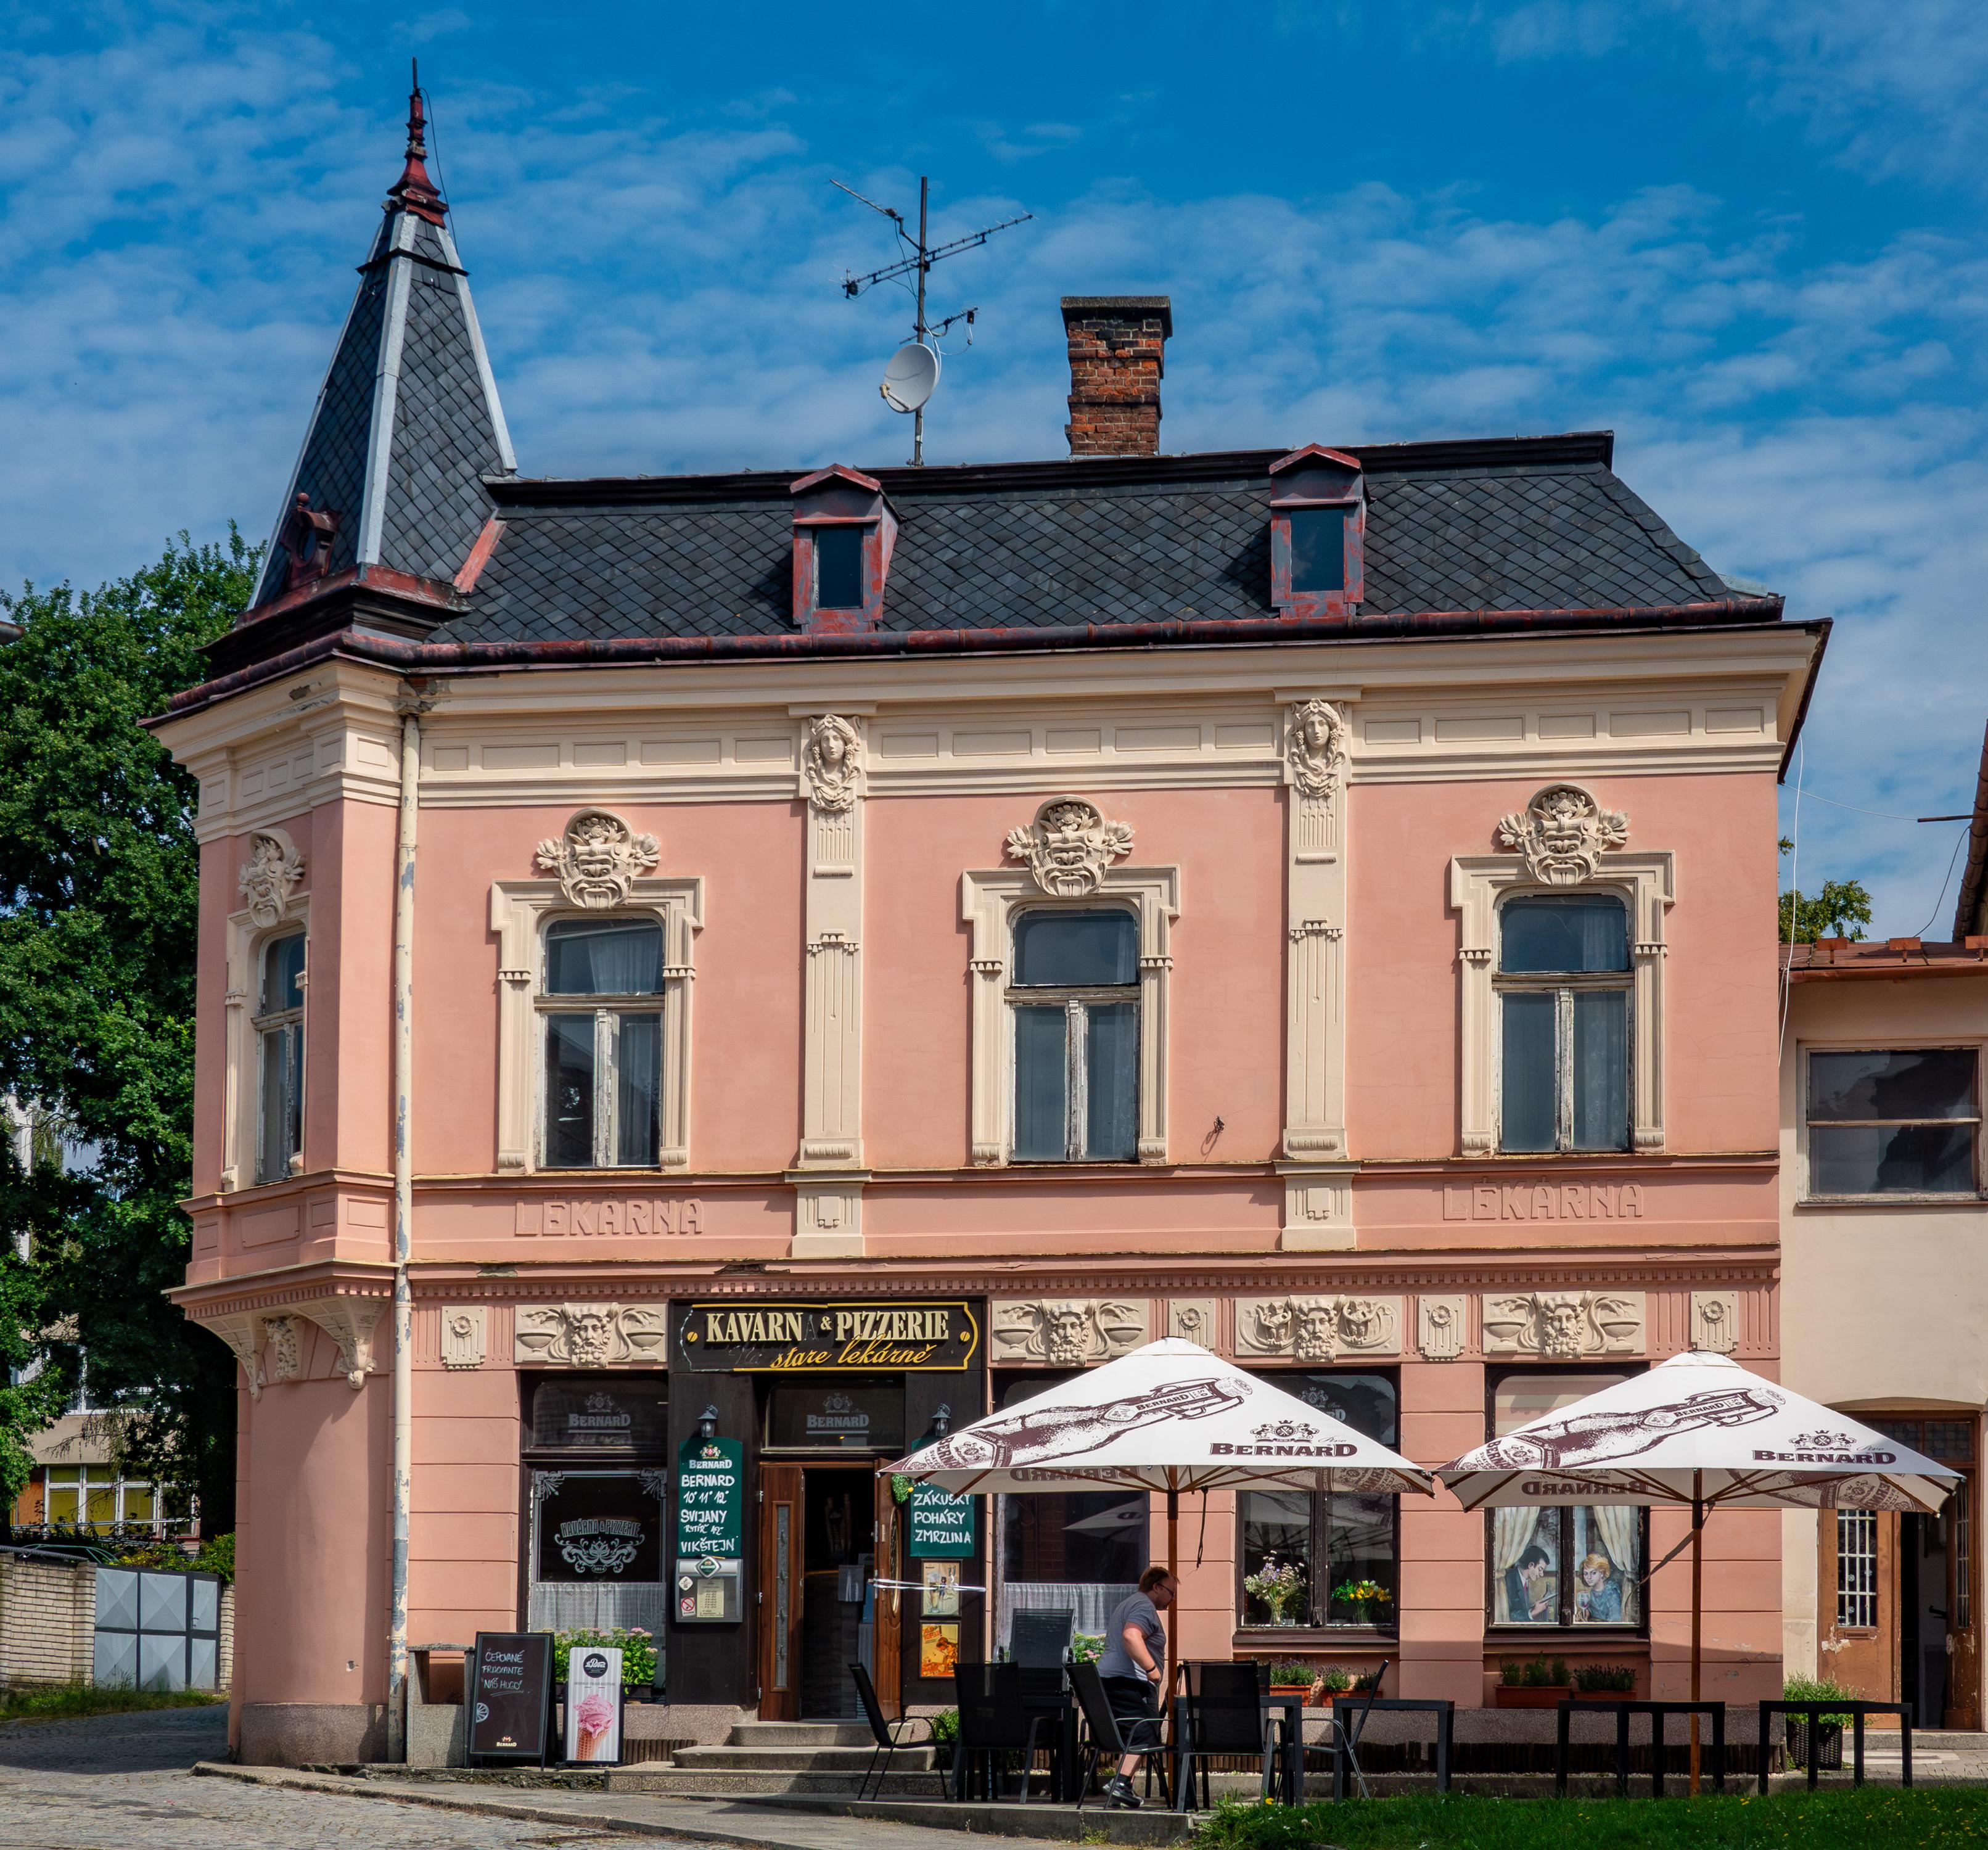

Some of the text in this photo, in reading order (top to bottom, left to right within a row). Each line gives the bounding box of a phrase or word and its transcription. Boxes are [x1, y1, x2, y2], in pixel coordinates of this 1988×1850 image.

[821, 1316, 832, 1331] &
[835, 1311, 949, 1341] PIZZERIE
[1136, 1394, 1189, 1410] BERNARD
[1674, 1402, 1724, 1417] BERNARD
[569, 1413, 631, 1427] BERNARD
[807, 1415, 869, 1428] BERNARD
[1209, 1443, 1358, 1457] BERNARD
[1752, 1450, 1897, 1465] BERNARD
[689, 1459, 733, 1469] BERNARD
[681, 1474, 735, 1487] BERNARD
[681, 1509, 727, 1523] SVIJANY
[914, 1508, 966, 1524] POHÁRY
[561, 1518, 599, 1538] KAVÁRNA
[605, 1519, 641, 1537] PIZZERIE
[915, 1529, 971, 1544] ZMRZLINA
[485, 1648, 525, 1663] ČEPOVANÉ
